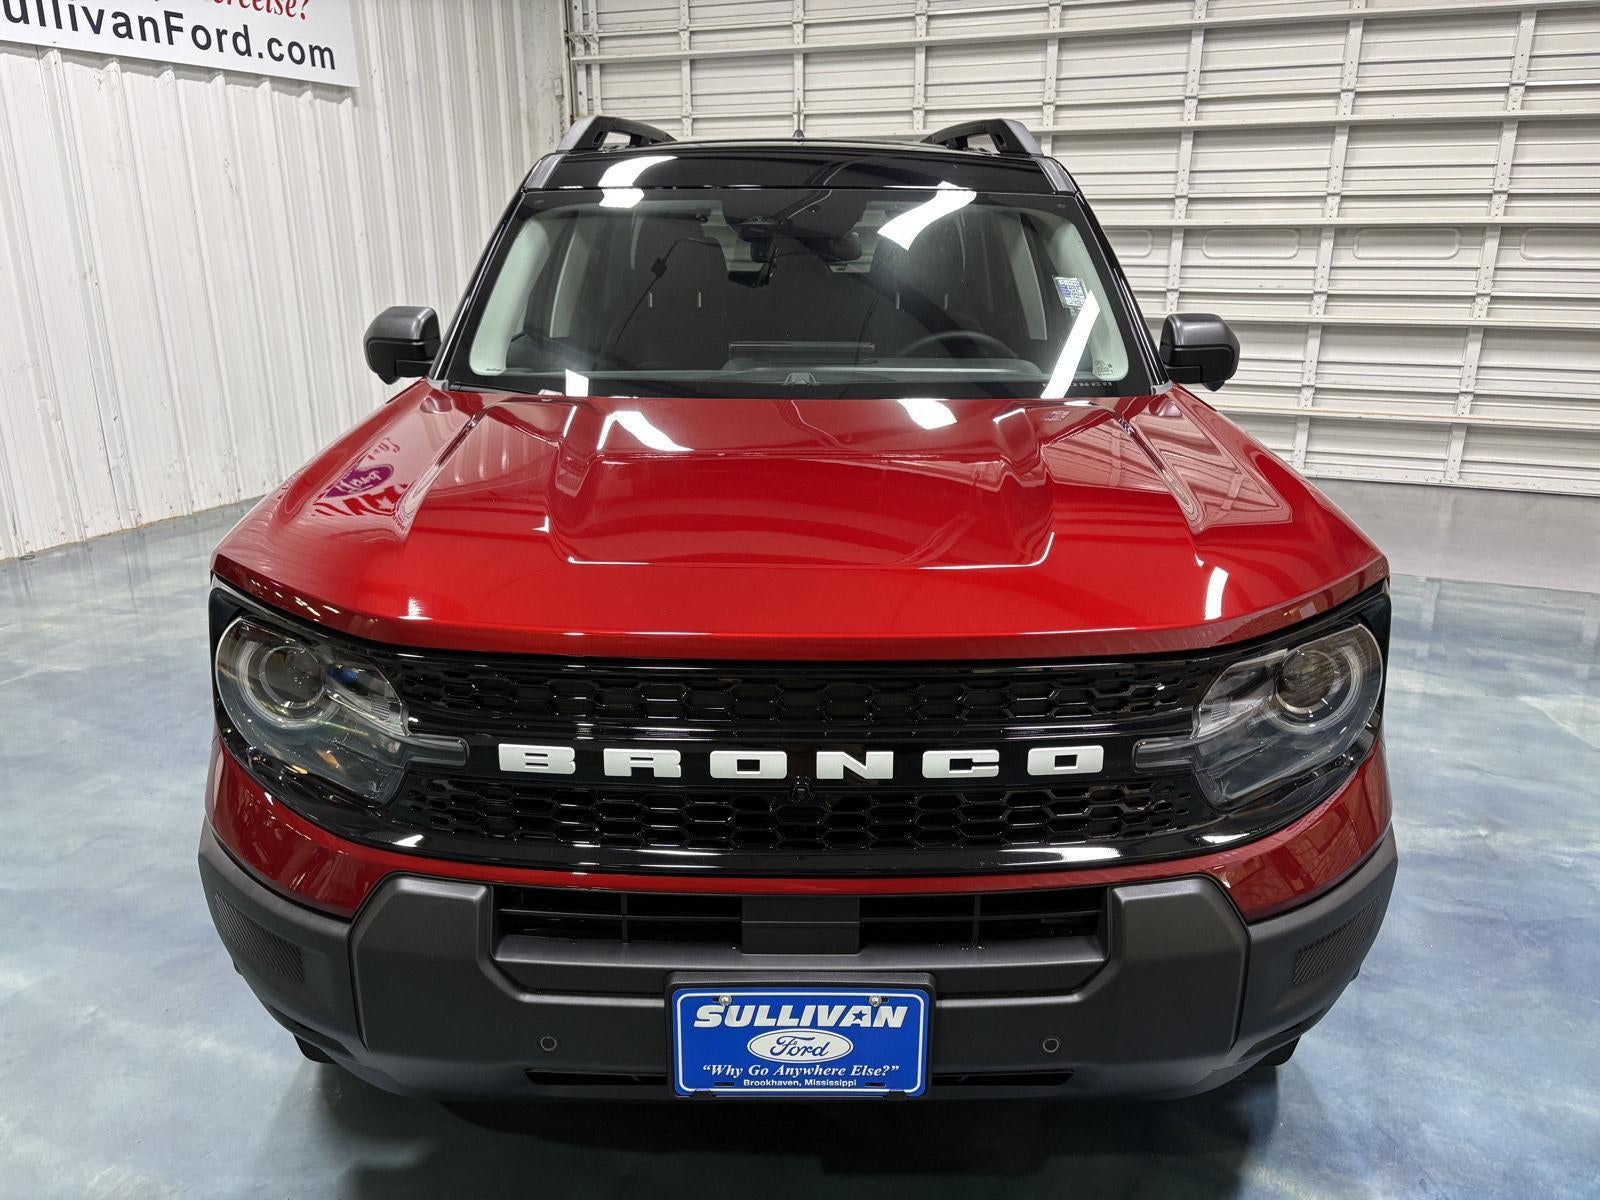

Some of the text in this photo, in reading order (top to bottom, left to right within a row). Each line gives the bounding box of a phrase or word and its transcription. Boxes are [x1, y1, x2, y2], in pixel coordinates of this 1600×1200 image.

[498, 743, 1104, 780] BRONCO
[693, 1004, 908, 1028] SULLIVAN
[769, 1035, 830, 1058] Ford
[748, 1064, 769, 1076] Go
[773, 1064, 846, 1078] Anywhere
[743, 1079, 857, 1088] Brookhaven, Mississippi
